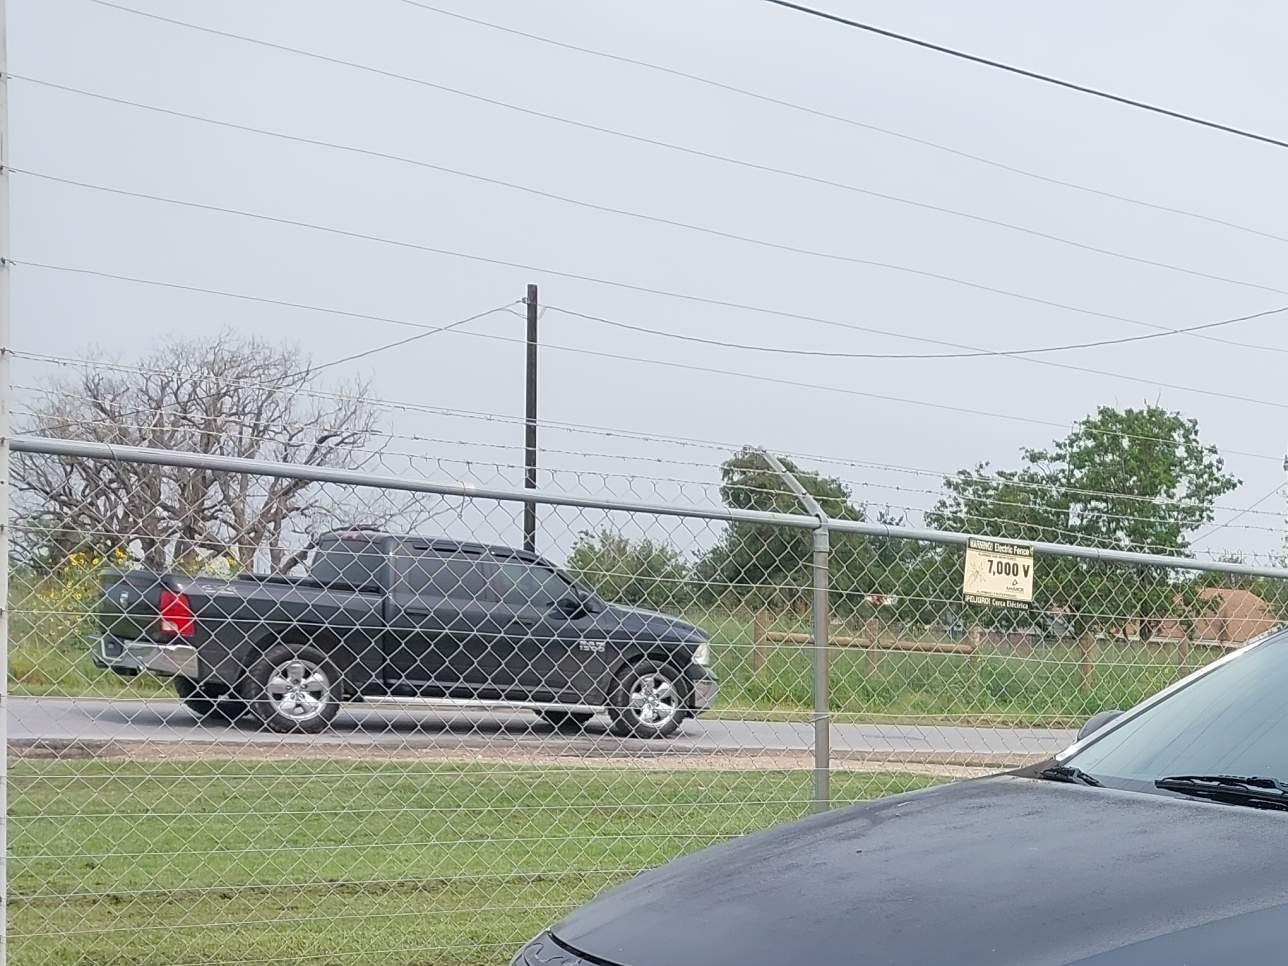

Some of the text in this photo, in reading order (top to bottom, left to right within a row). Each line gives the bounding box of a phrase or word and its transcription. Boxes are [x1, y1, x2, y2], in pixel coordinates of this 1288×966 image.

[1014, 546, 1029, 556] Fence
[987, 560, 1030, 578] 7,000 V
[992, 599, 1006, 607] Cerca
